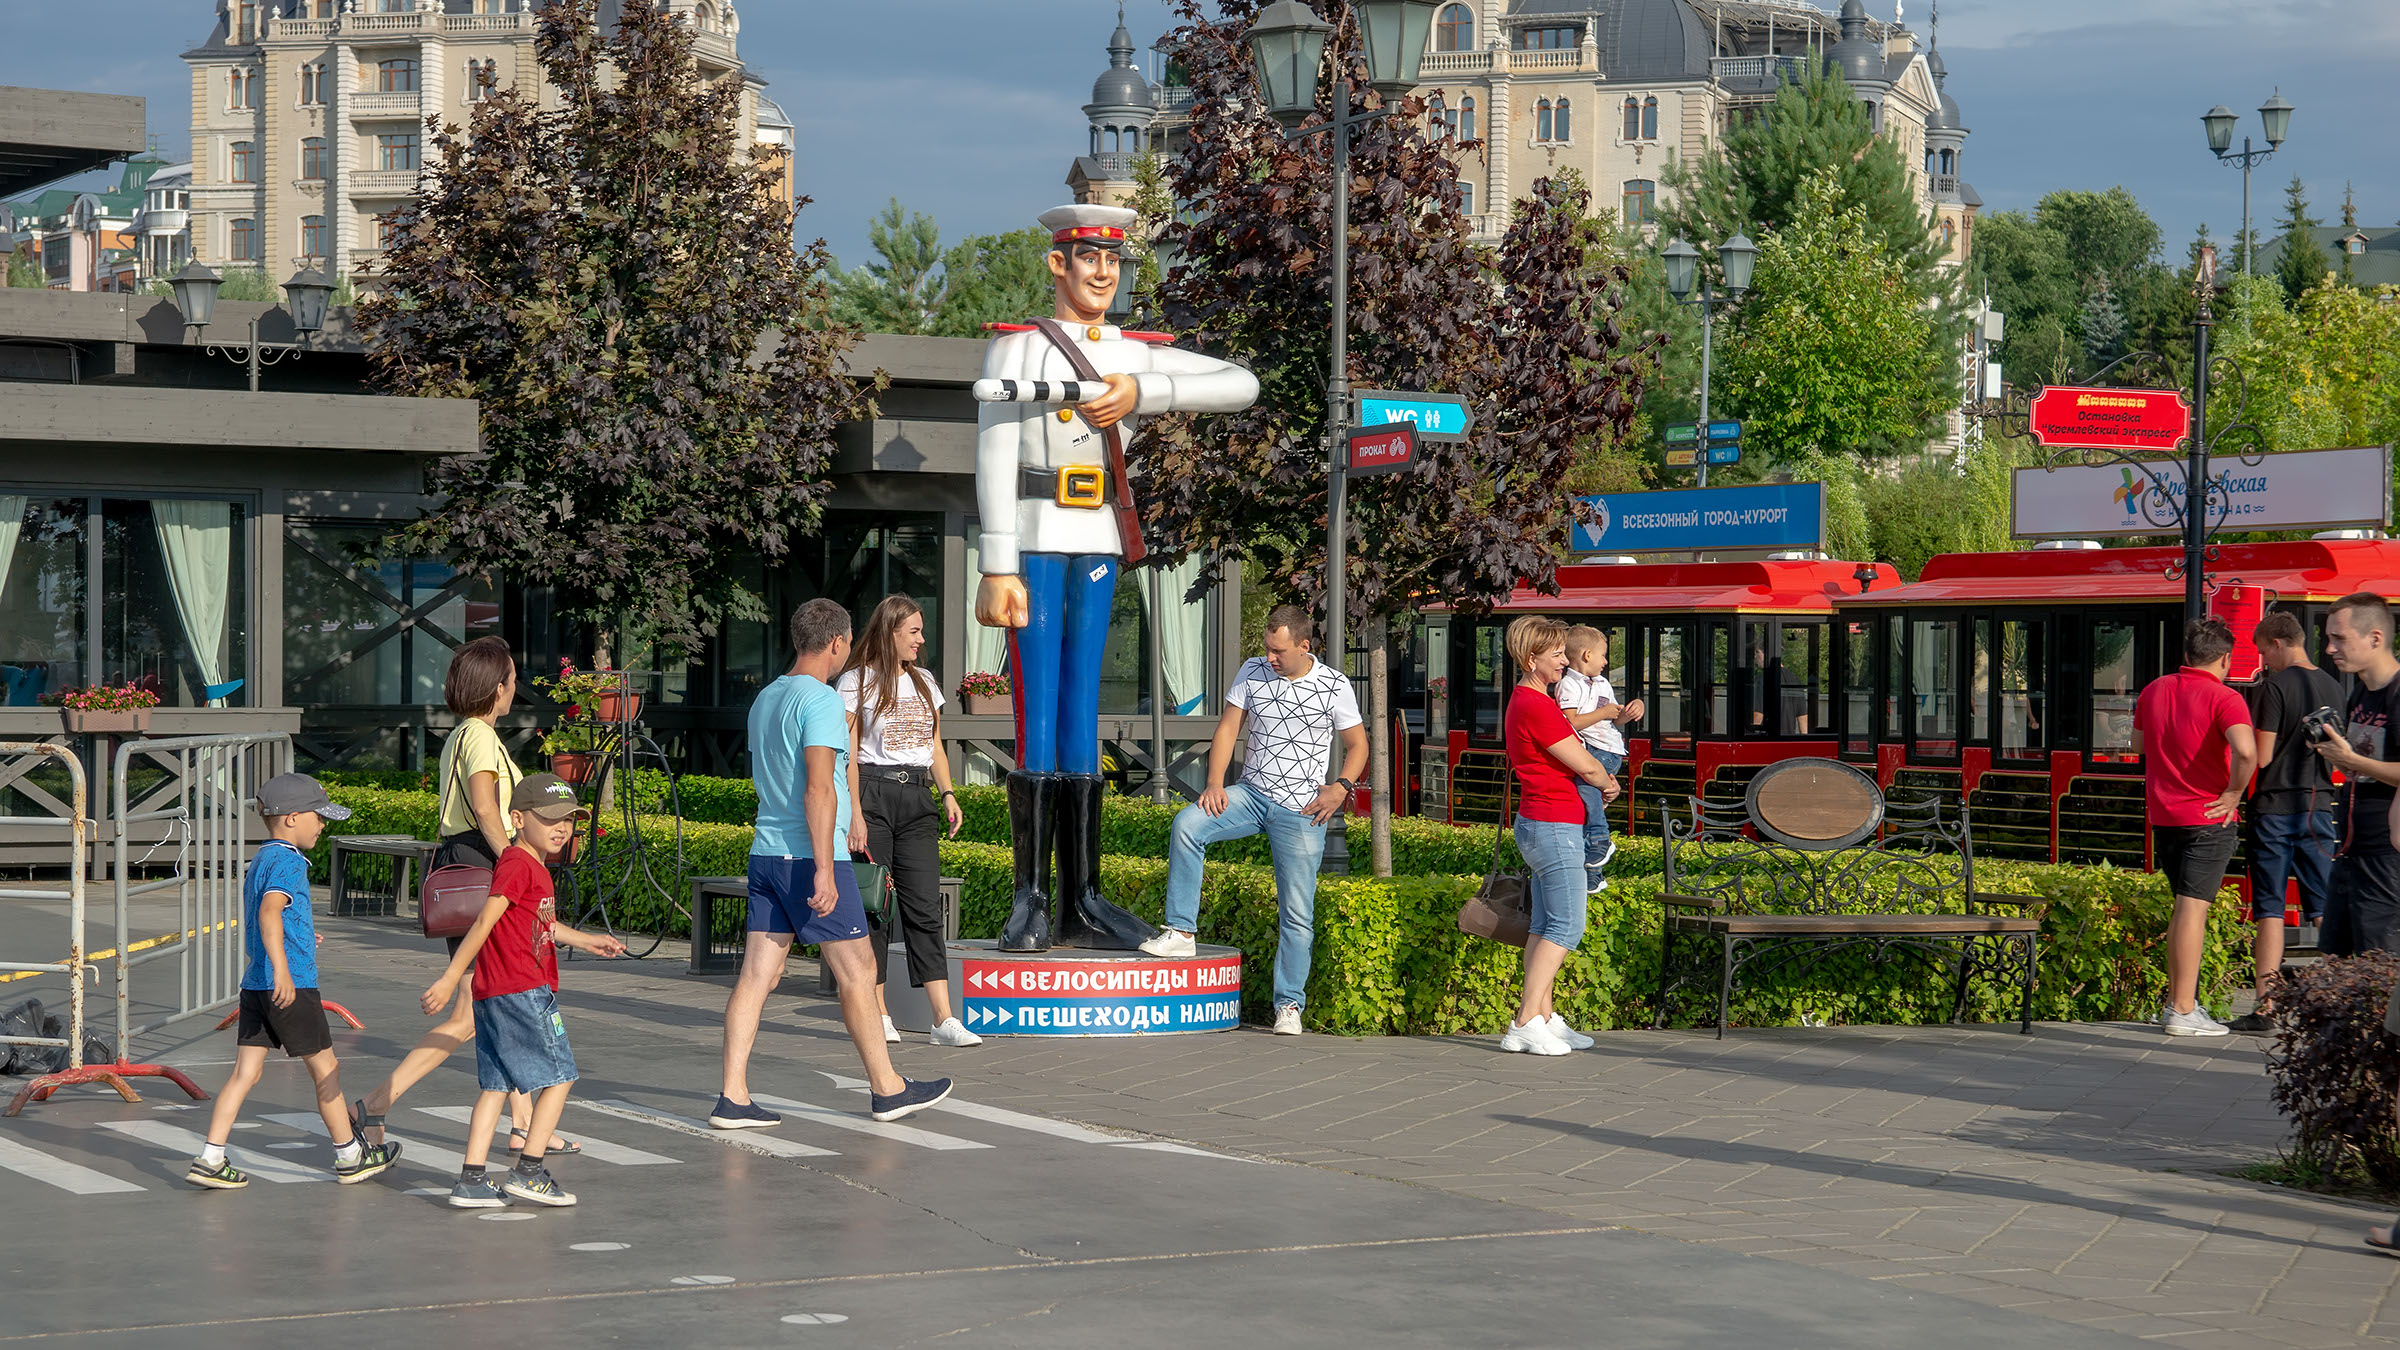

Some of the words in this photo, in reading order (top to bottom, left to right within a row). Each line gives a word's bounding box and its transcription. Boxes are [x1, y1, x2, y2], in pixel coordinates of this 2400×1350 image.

[1385, 408, 1418, 425] WC
[2078, 410, 2141, 423] Остановка
[1359, 444, 1387, 458] ПРОКАТ
[1715, 451, 1725, 460] WC
[1622, 508, 1699, 529] ВСЕСЕЗОННЫЙ
[1704, 507, 1788, 527] ГОРОД-КУРОРТ
[1020, 968, 1189, 994] ВЕЛОСИПЕДЫ
[1196, 964, 1241, 988] НАЛЕВО
[1018, 1004, 1170, 1030] ПЕШЕХОДЫ
